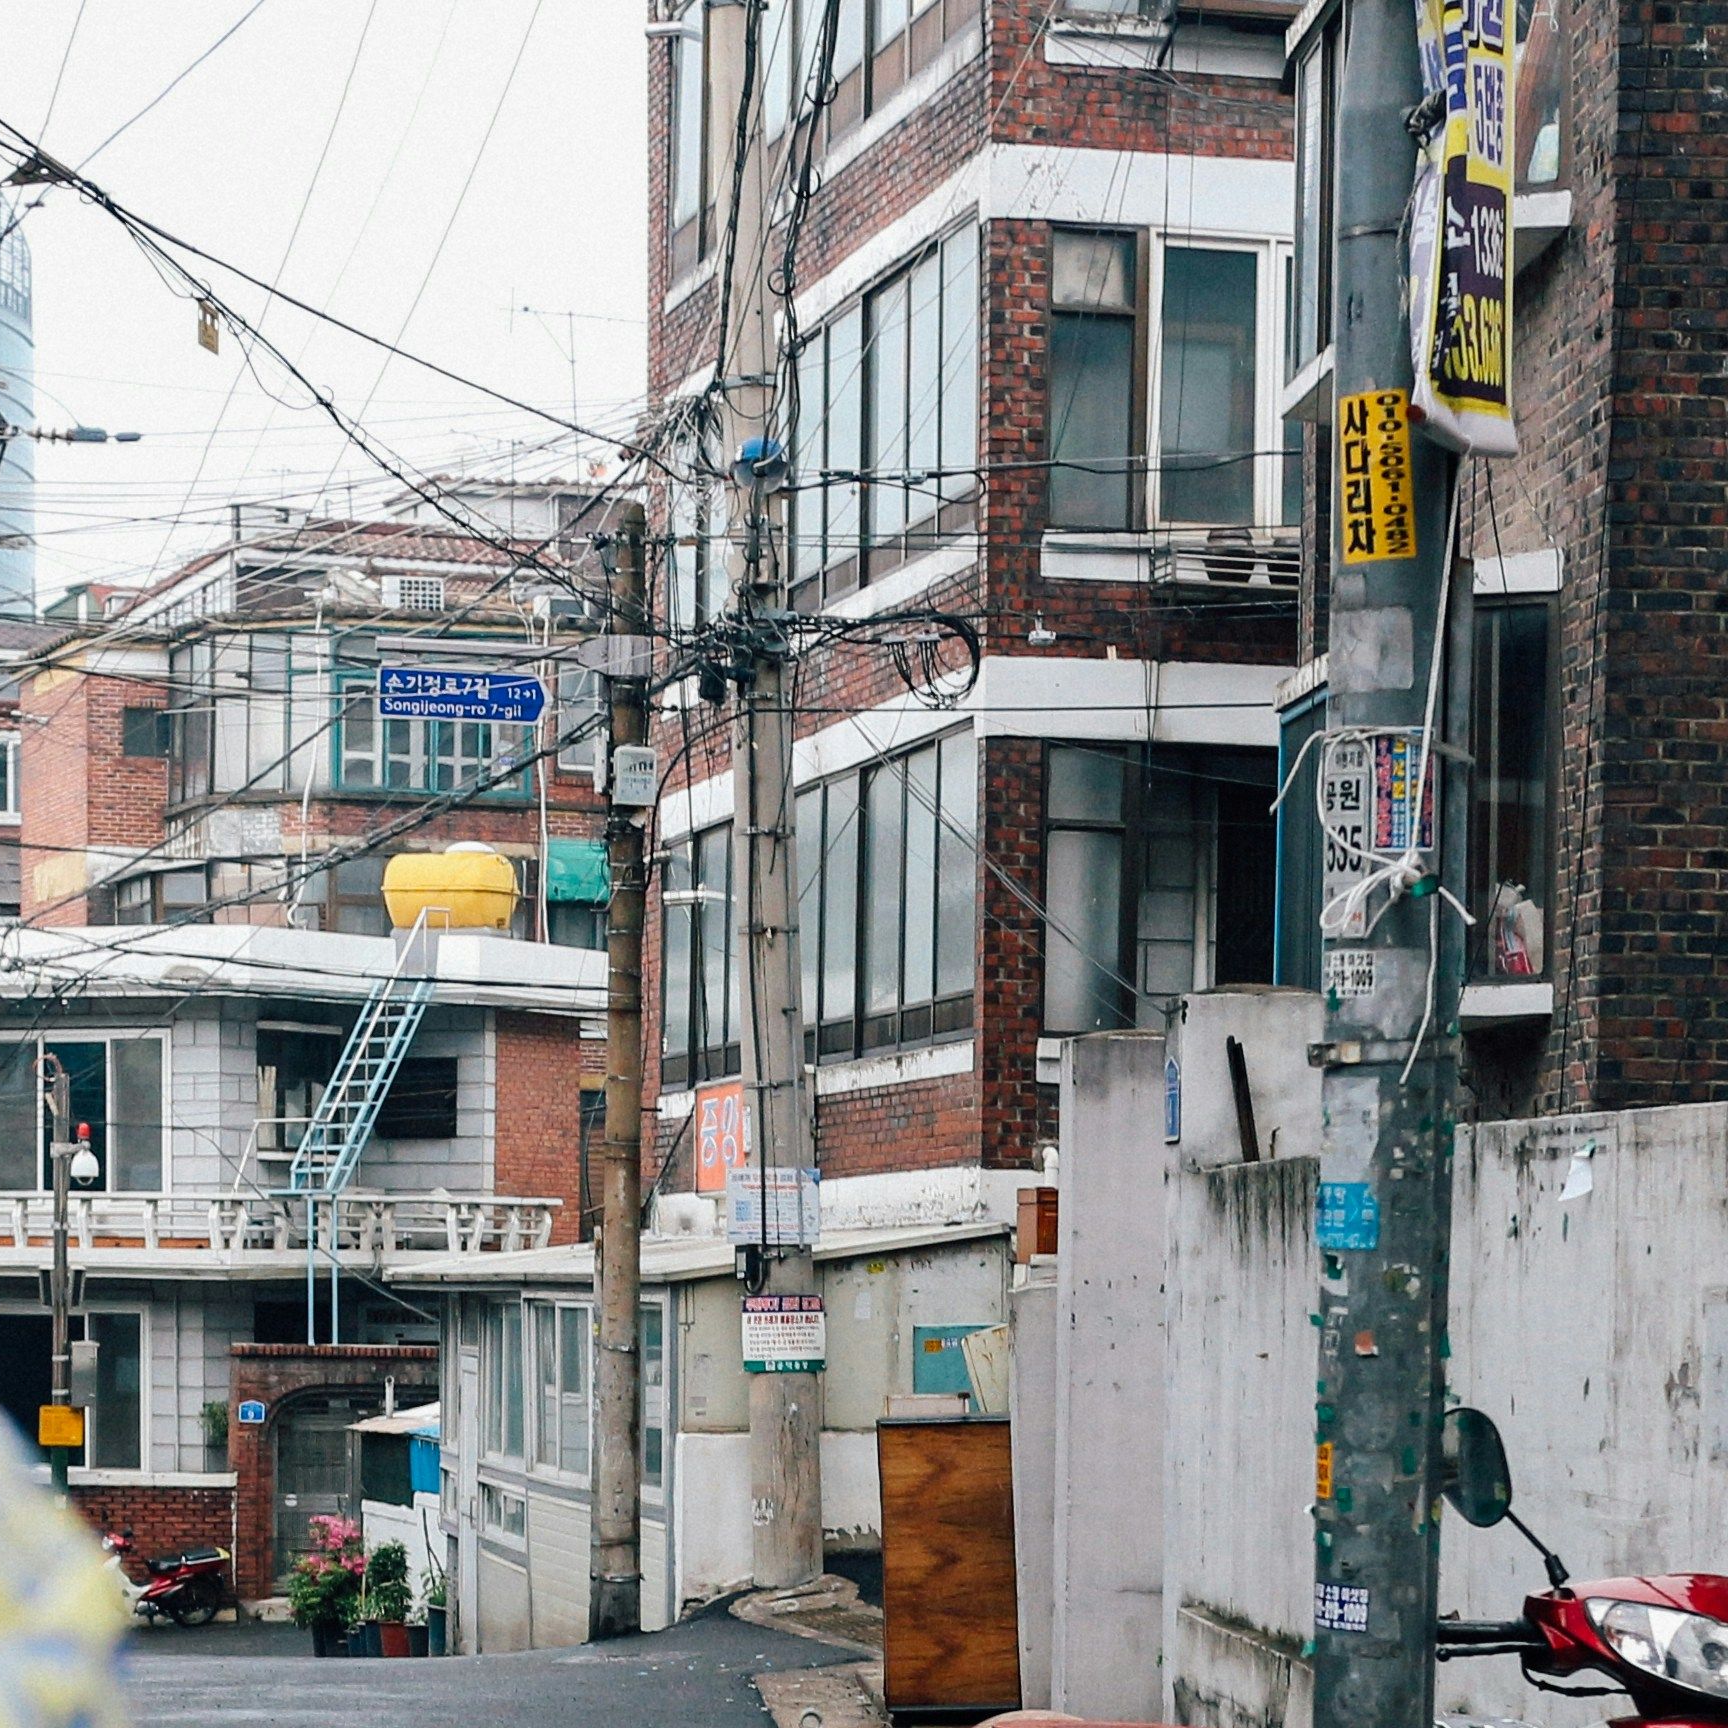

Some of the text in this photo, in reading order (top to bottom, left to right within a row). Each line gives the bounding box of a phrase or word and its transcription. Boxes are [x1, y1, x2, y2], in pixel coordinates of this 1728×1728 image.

[1342, 397, 1377, 558] 사다리차
[385, 672, 491, 700] 손기정로7길
[384, 697, 522, 718] Songijeong-ro 7-gil
